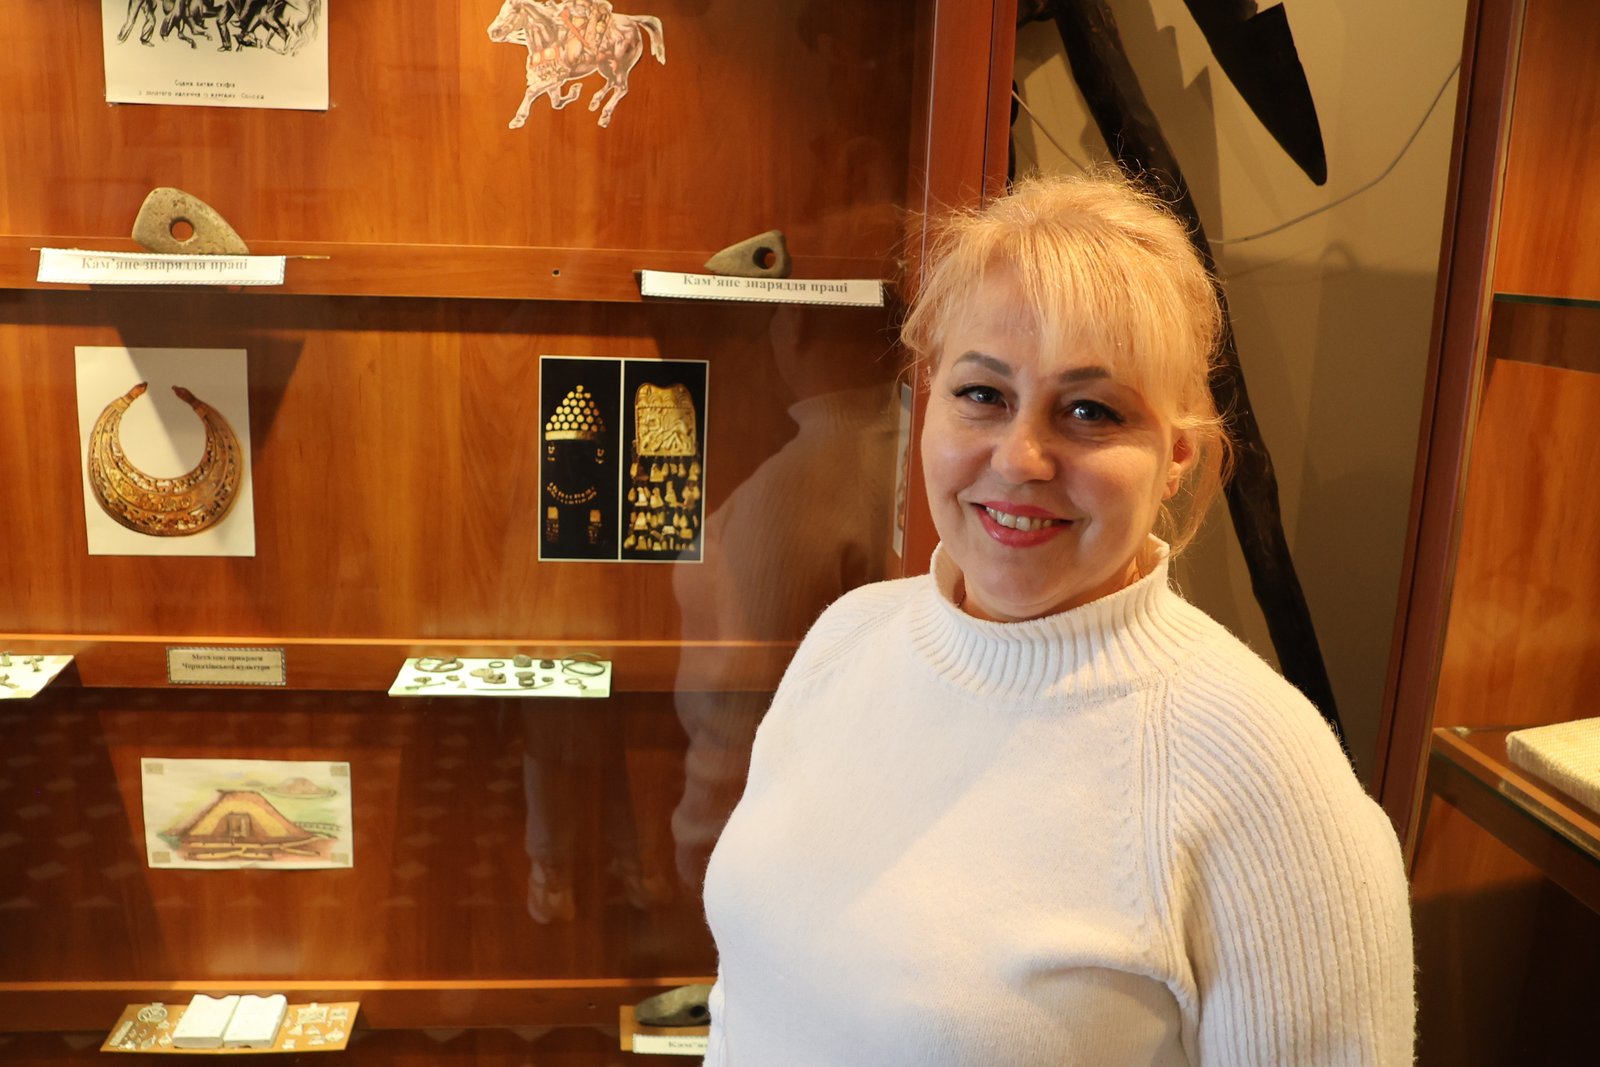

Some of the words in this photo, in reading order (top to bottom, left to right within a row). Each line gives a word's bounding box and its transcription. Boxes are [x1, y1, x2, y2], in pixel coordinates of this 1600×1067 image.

[144, 260, 206, 273] знаряддя
[210, 259, 248, 273] праці
[745, 280, 806, 292] знаряддя
[811, 283, 848, 295] праці
